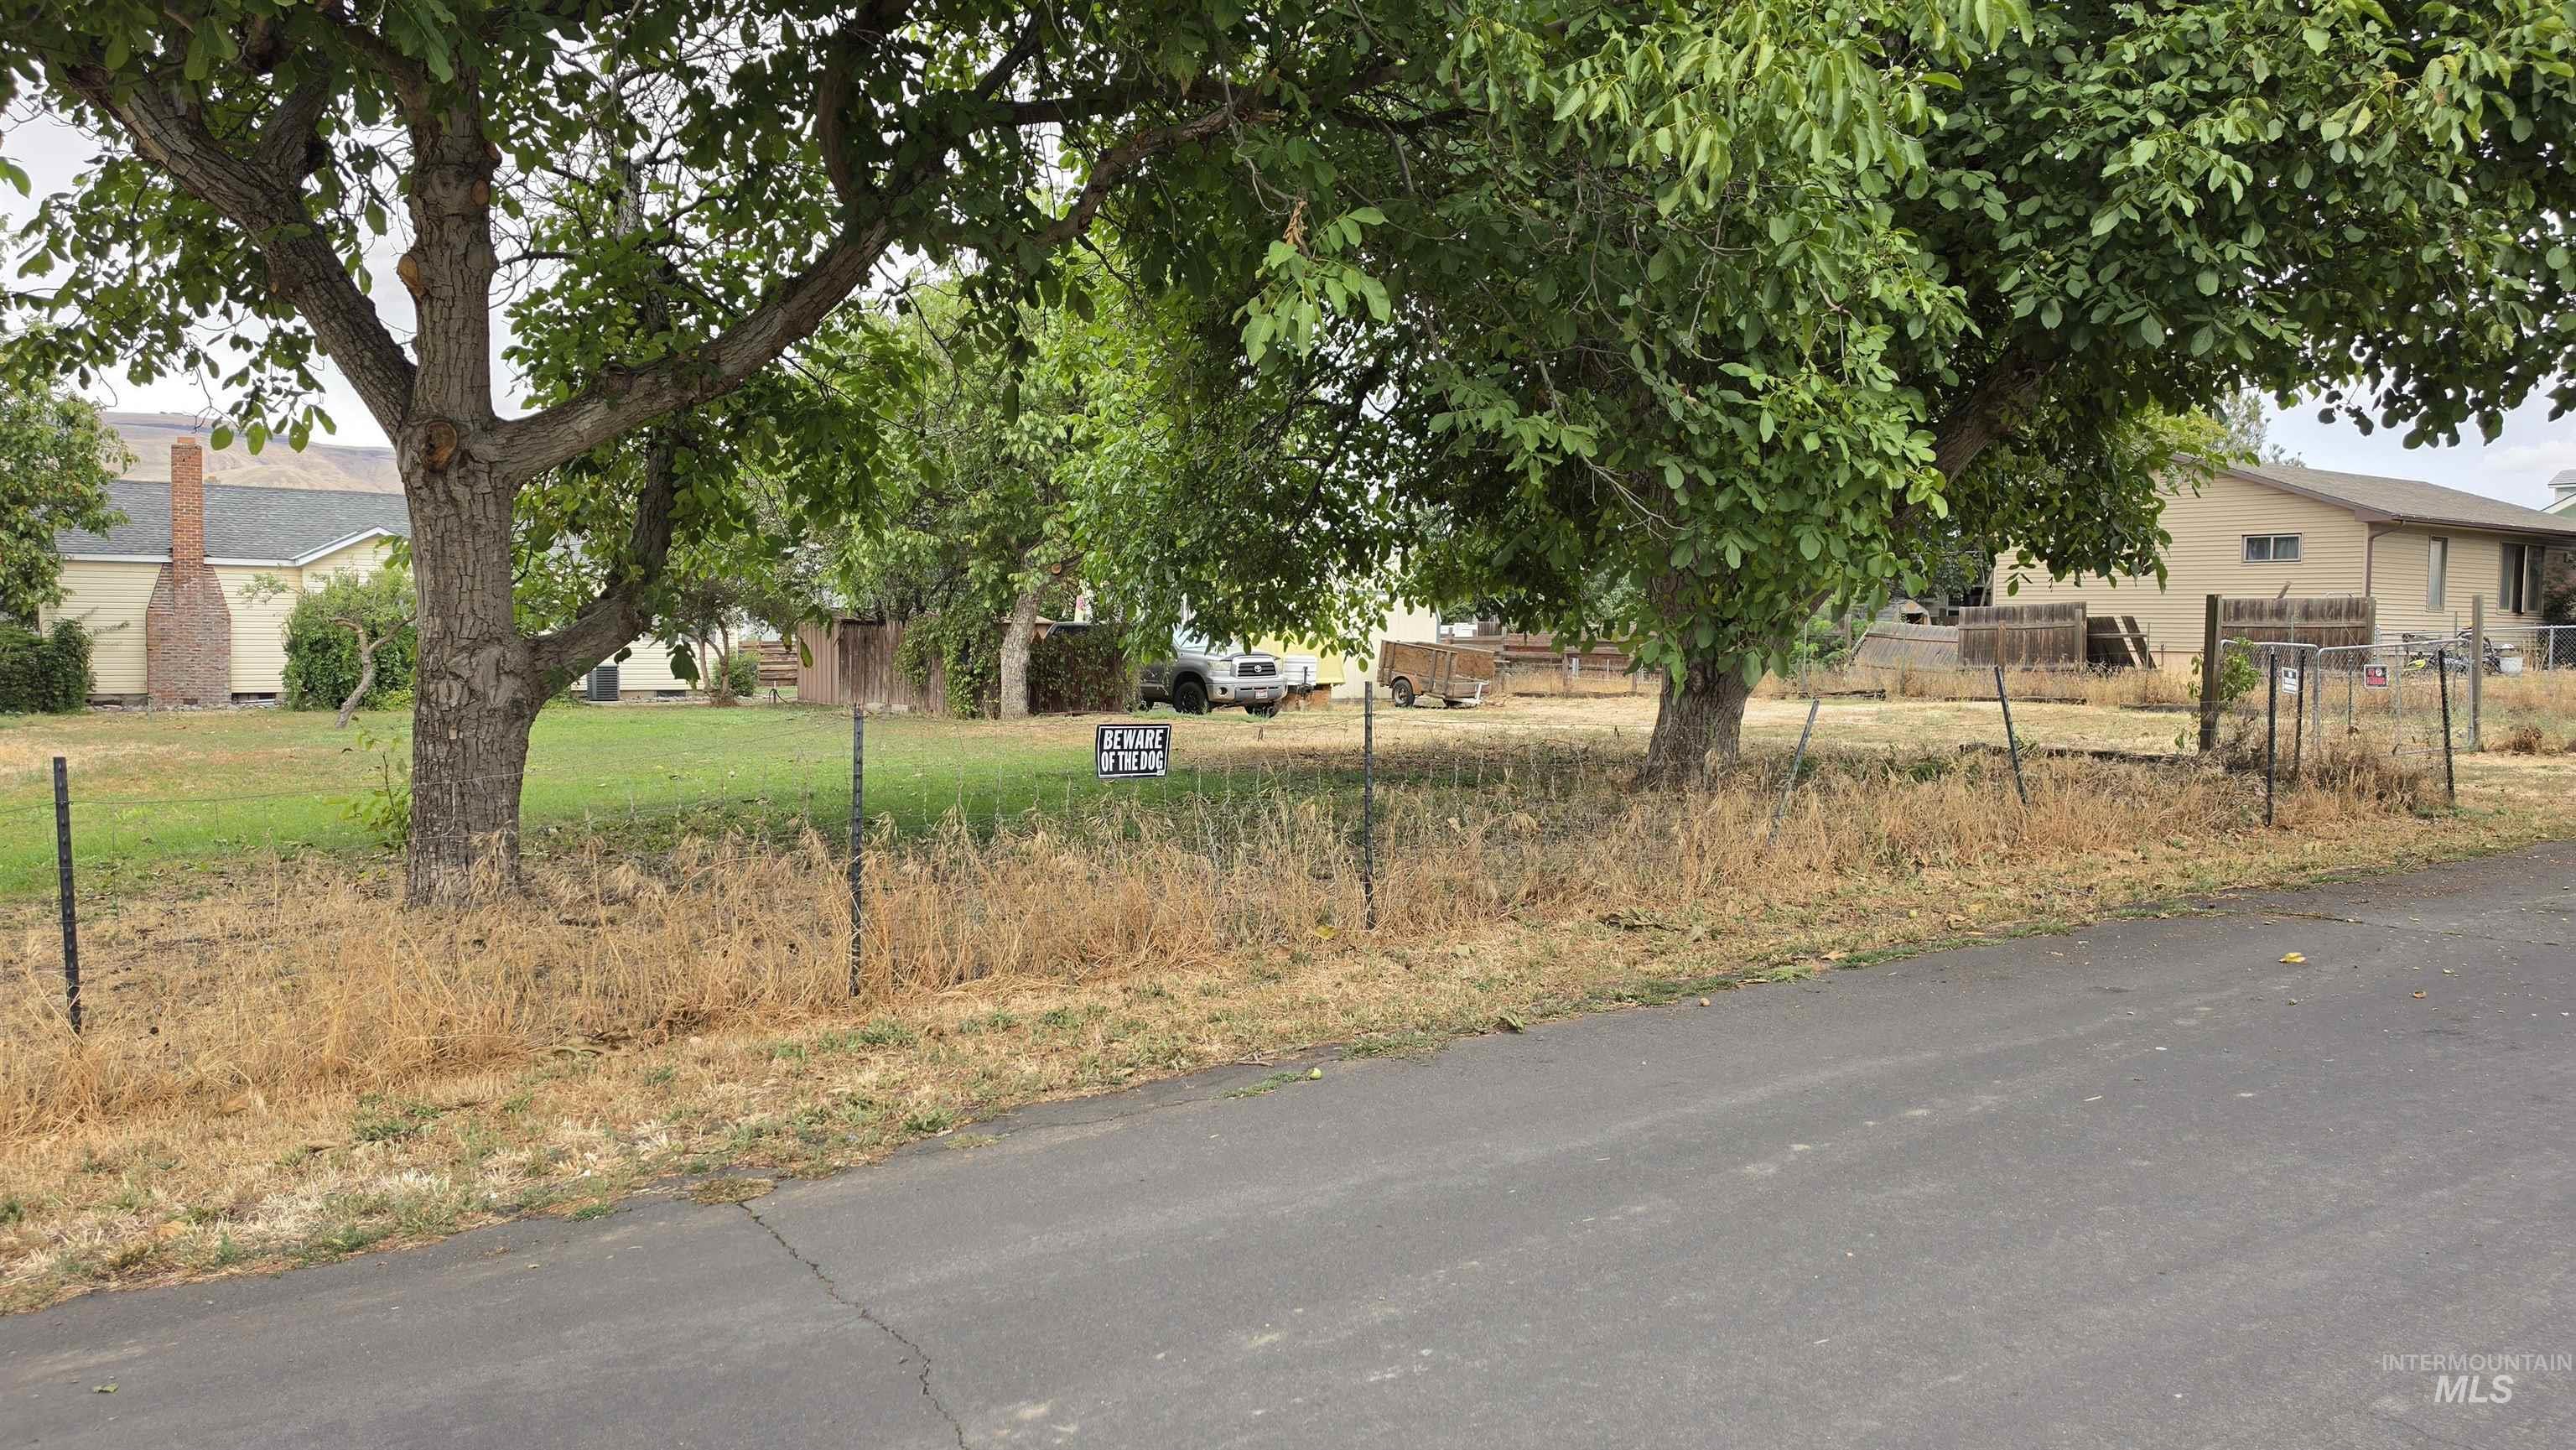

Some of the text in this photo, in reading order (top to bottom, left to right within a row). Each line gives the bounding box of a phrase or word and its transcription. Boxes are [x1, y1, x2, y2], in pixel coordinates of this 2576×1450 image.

[1104, 730, 1164, 750] BEWARE
[1101, 751, 1164, 772] OF THE DOG
